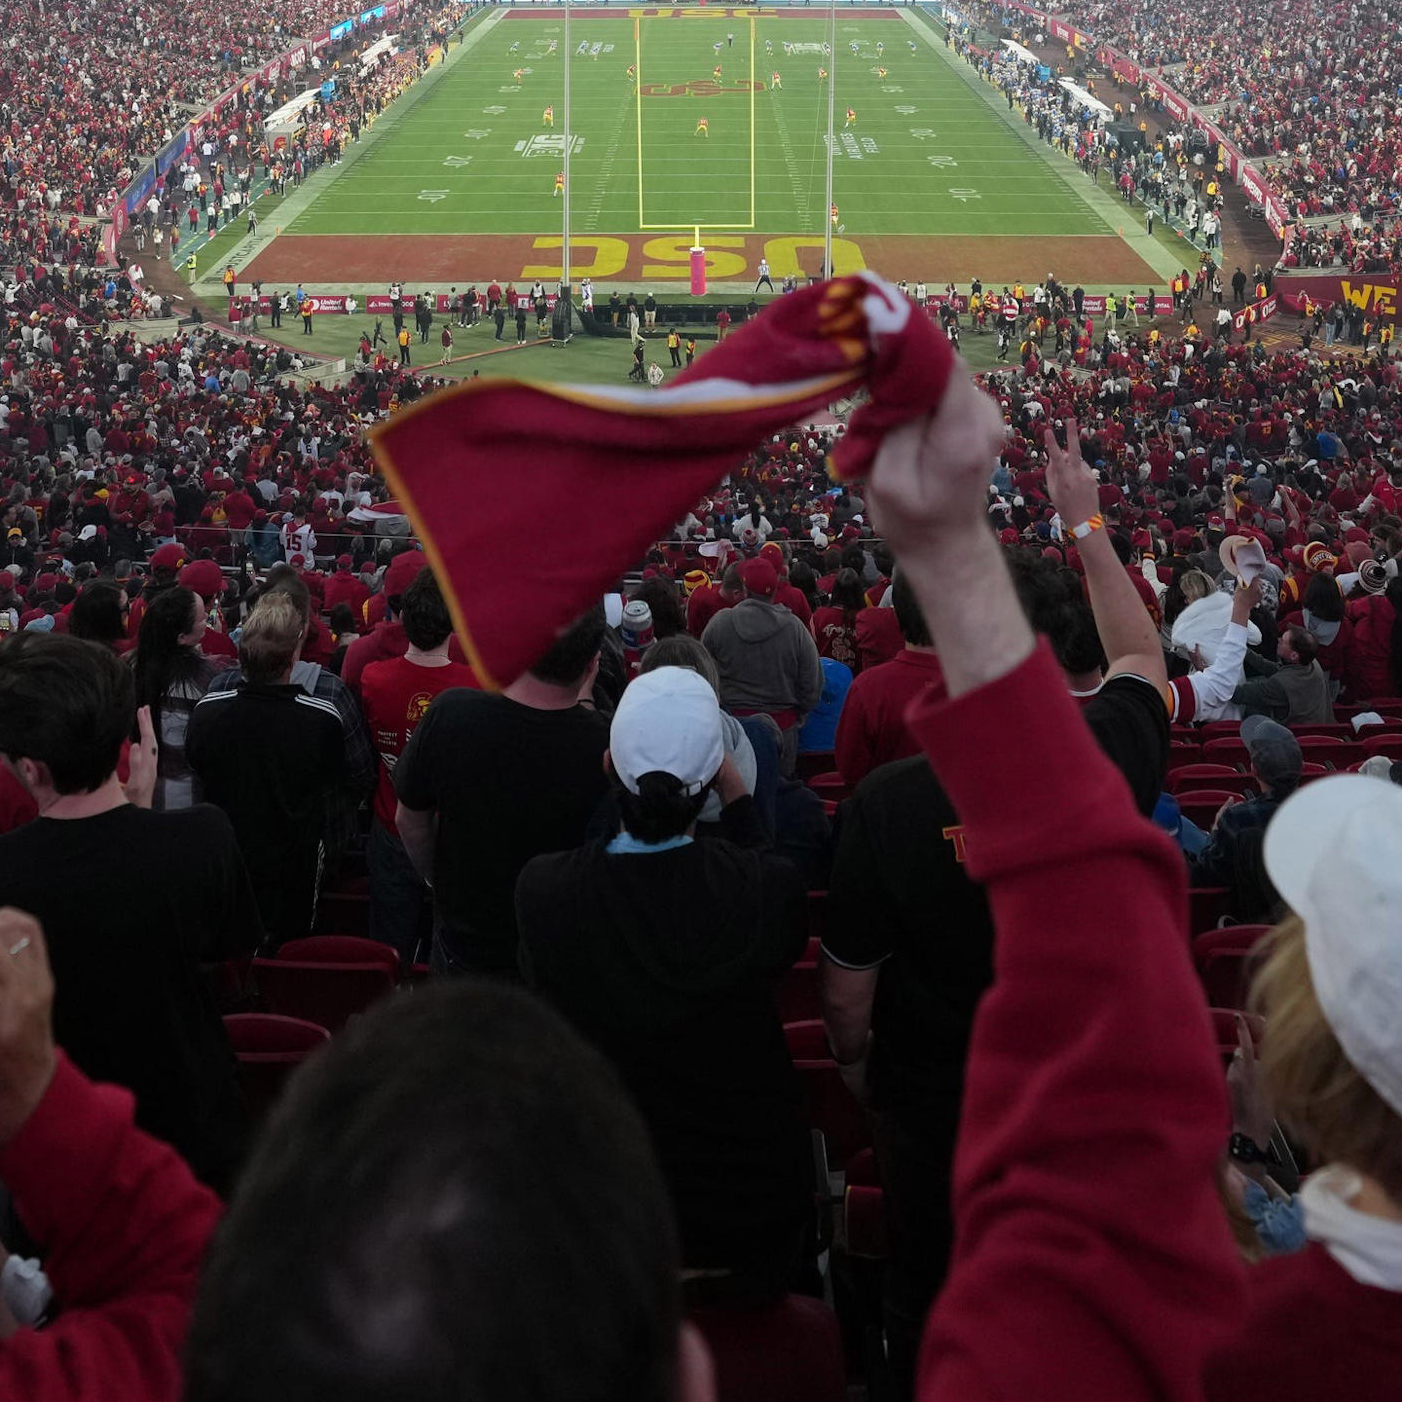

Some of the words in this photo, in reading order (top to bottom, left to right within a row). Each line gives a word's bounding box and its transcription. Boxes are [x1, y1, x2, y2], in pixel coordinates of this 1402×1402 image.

[628, 9, 779, 18] USC
[1341, 281, 1397, 316] WE
[305, 445, 312, 454] 6
[286, 533, 303, 552] 15
